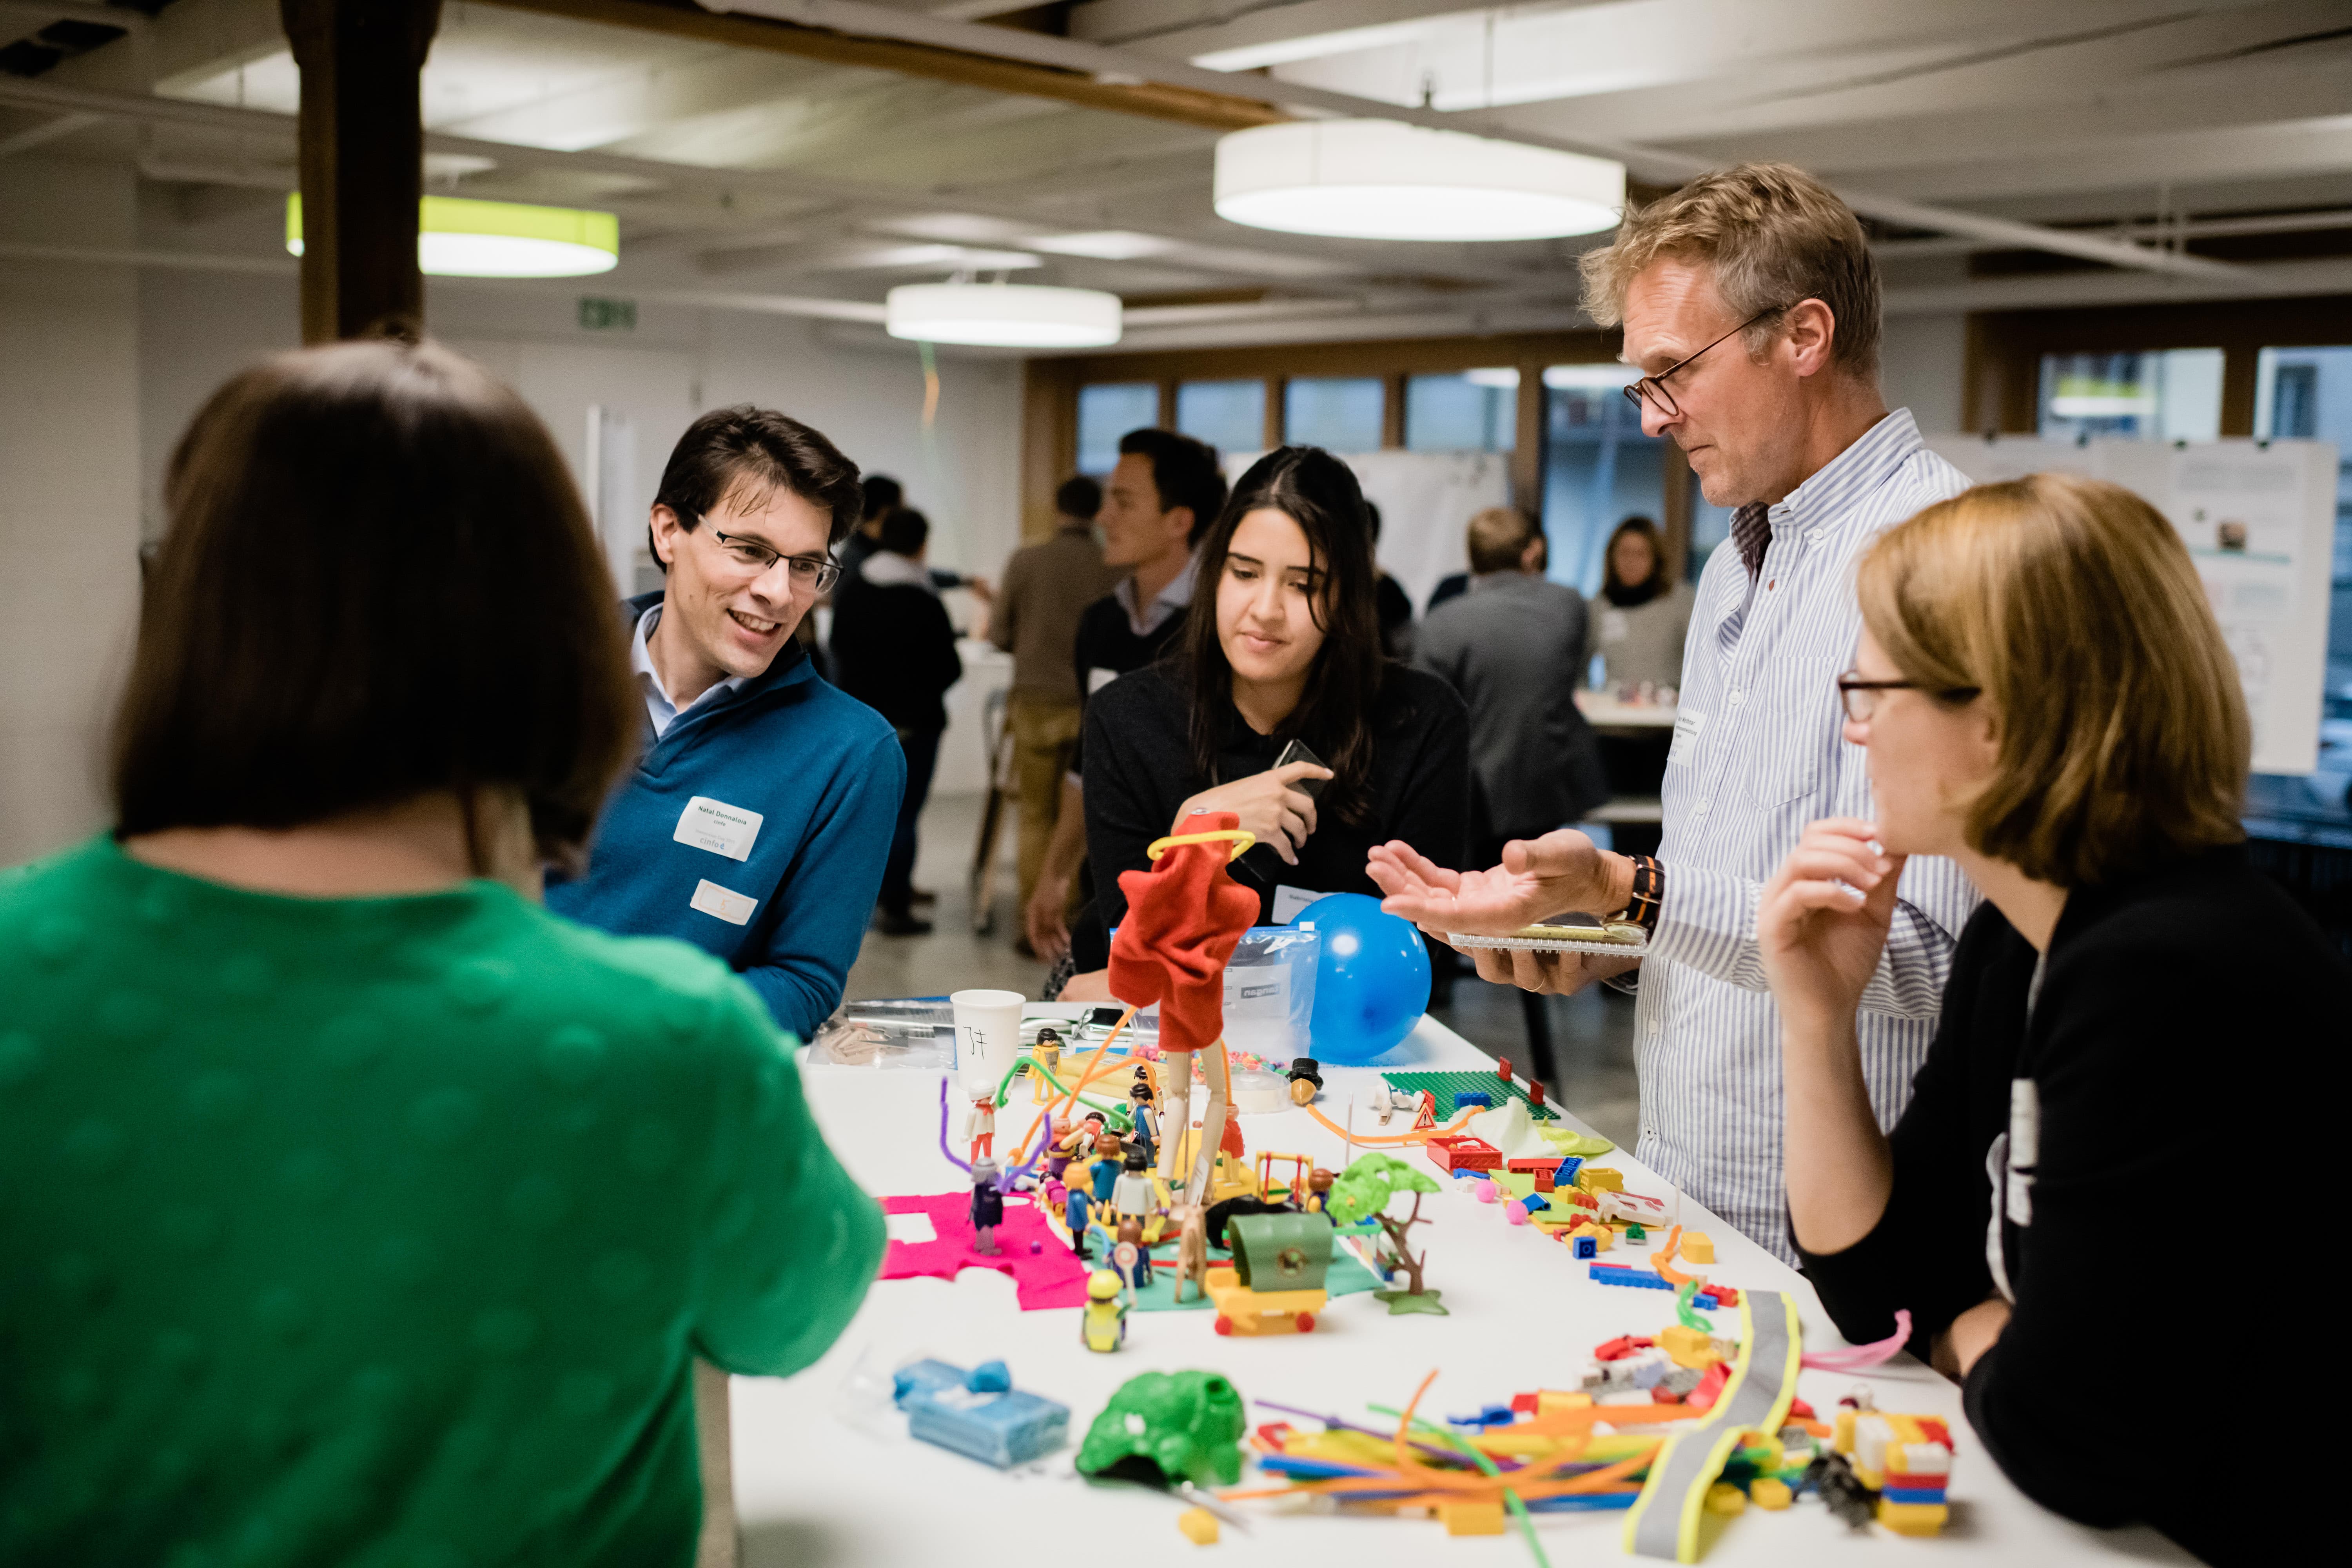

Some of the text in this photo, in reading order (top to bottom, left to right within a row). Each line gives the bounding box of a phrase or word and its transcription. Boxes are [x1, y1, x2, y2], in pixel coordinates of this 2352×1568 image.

[698, 806, 747, 825] Natal Donnaloia
[700, 837, 719, 848] cinfo
